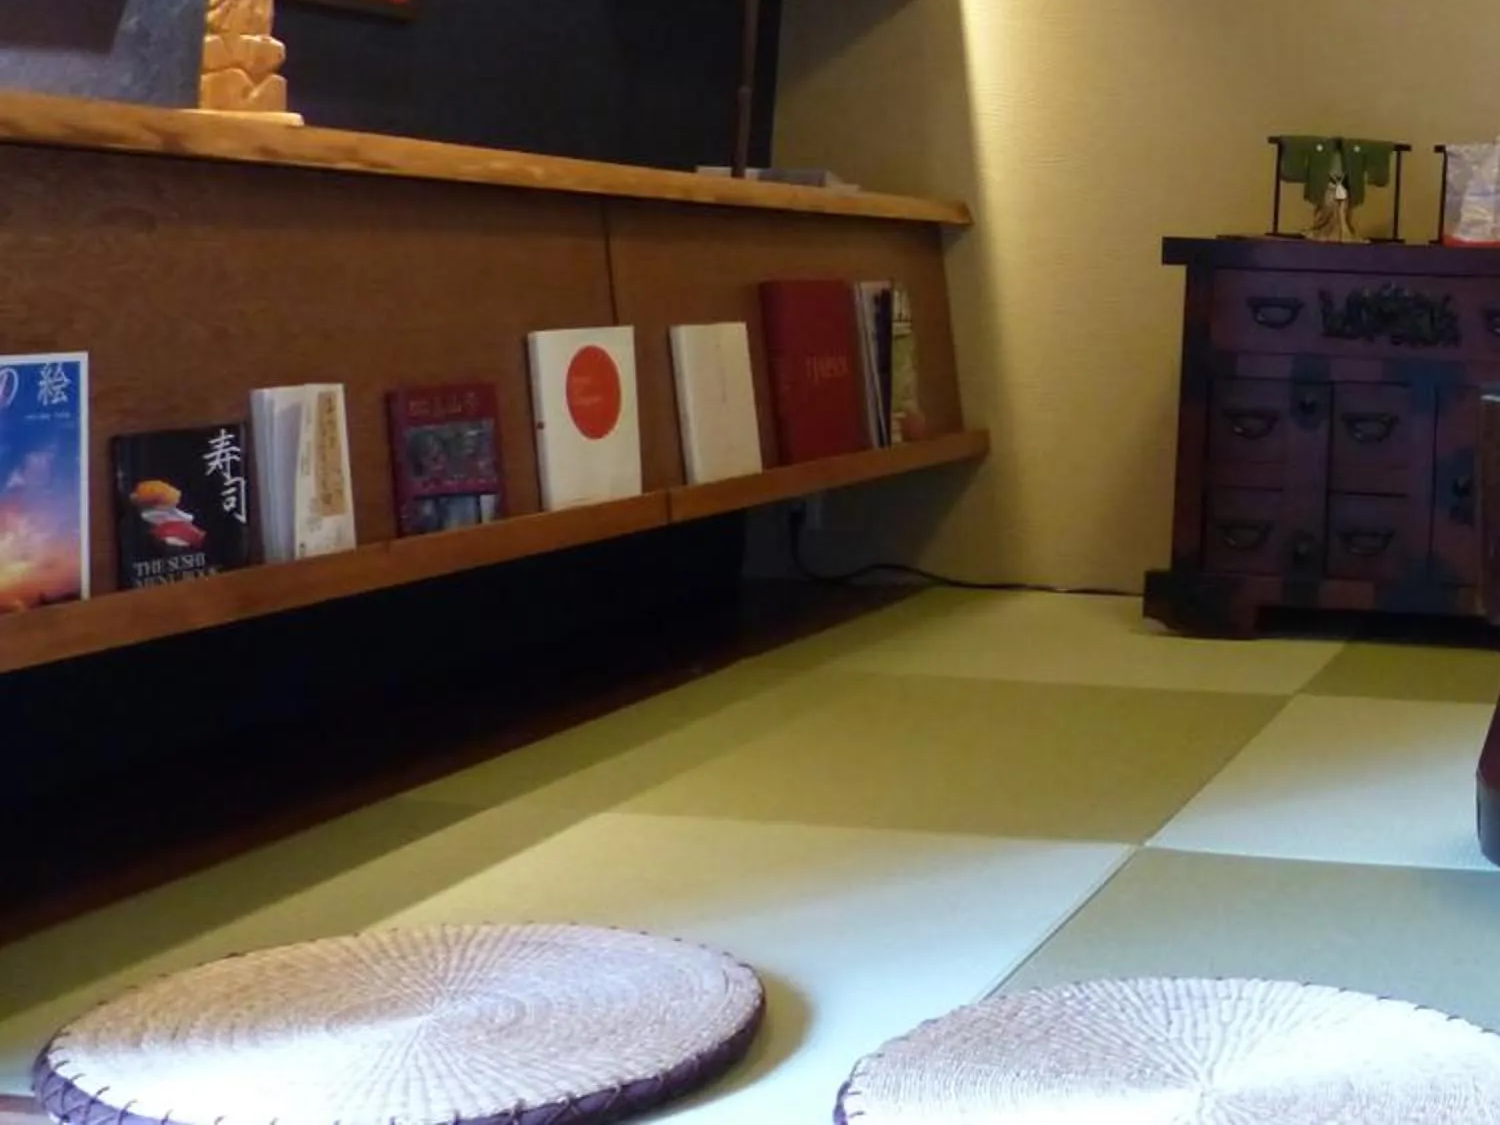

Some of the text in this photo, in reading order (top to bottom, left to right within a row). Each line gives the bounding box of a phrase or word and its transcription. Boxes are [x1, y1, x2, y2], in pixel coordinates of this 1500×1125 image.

[203, 428, 247, 524] 寿司
[132, 559, 165, 576] THE
[168, 552, 206, 572] SUSHI
